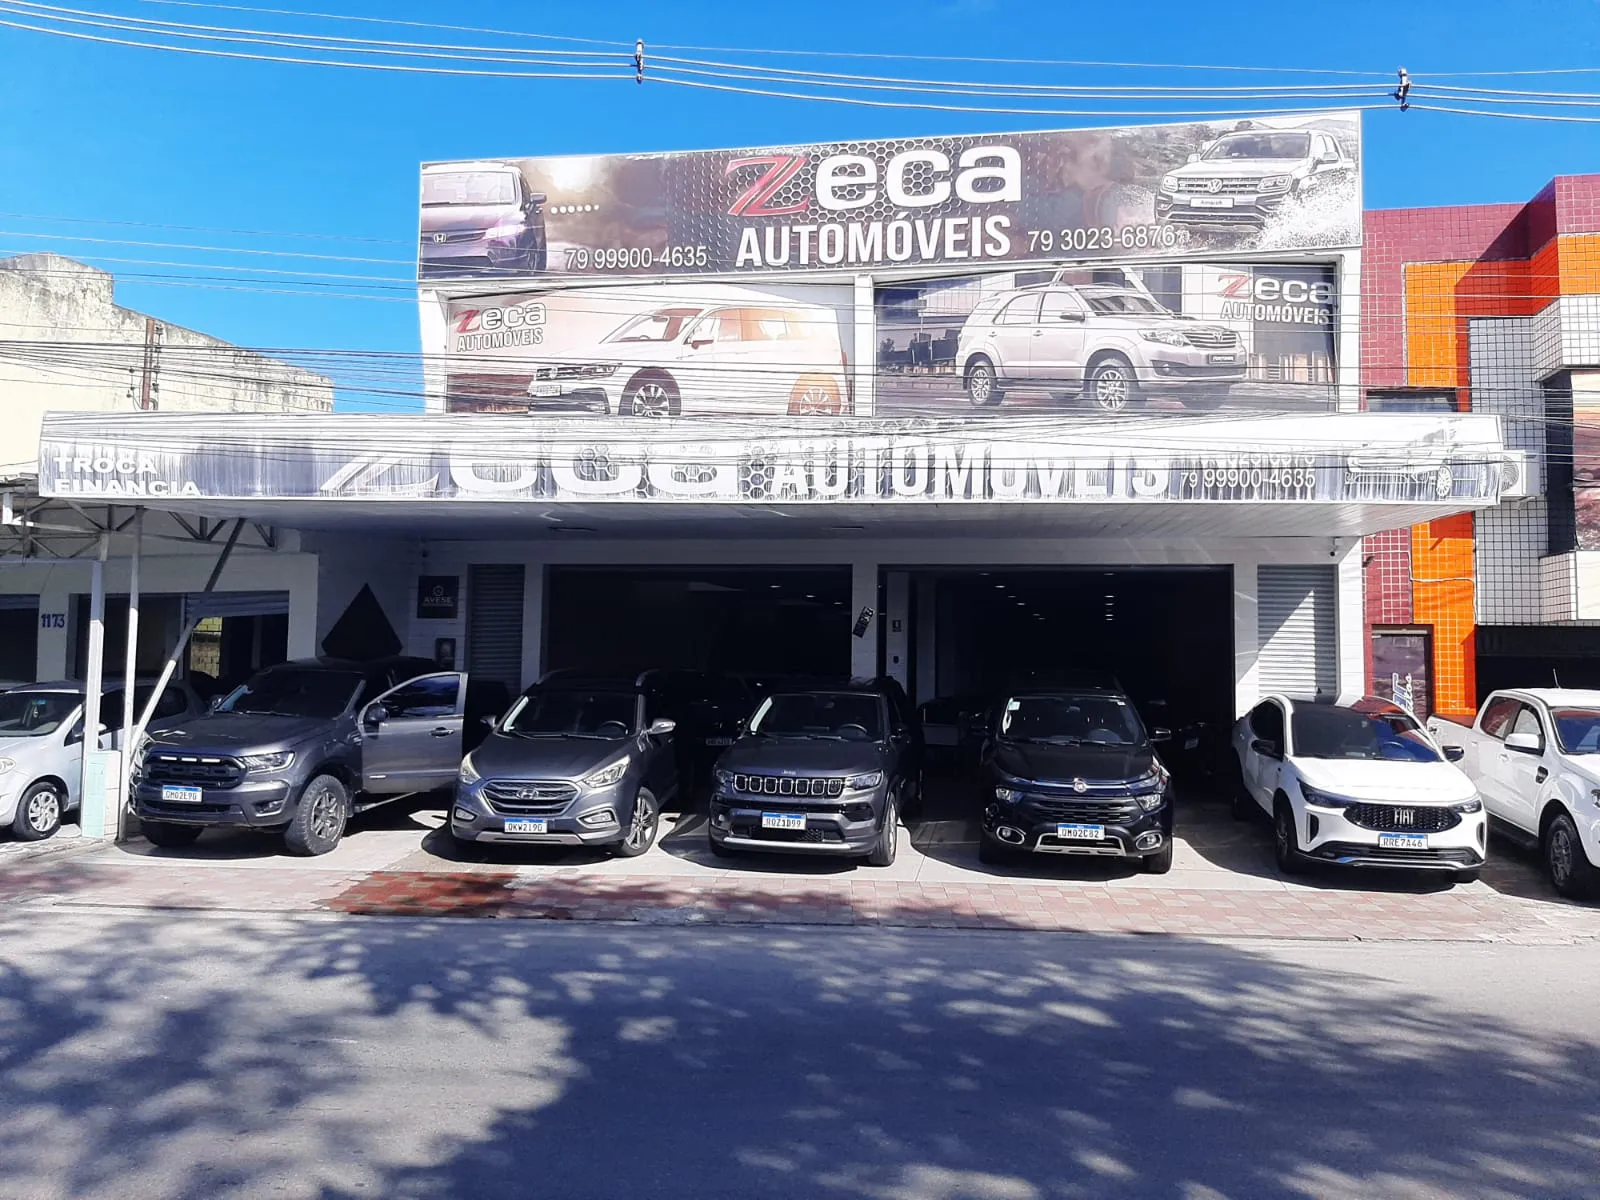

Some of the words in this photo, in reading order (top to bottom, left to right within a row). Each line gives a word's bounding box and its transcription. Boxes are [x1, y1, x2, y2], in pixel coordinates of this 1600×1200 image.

[735, 211, 1012, 268] AUTOMÓVEIS
[1027, 230, 1054, 252] 79
[1060, 225, 1176, 251] 3023-6876
[564, 249, 589, 271] 79
[594, 246, 708, 269] 99900-4635
[1219, 300, 1331, 325] AUTOMÓVEIS
[456, 326, 544, 353] AUTOMÓVEIS
[53, 456, 158, 474] TROCA
[54, 478, 202, 497] FINANCIA
[1180, 472, 1198, 488] 79
[1203, 468, 1316, 488] 99900-4635
[41, 613, 66, 628] 1173
[1393, 808, 1416, 825] FIAT
